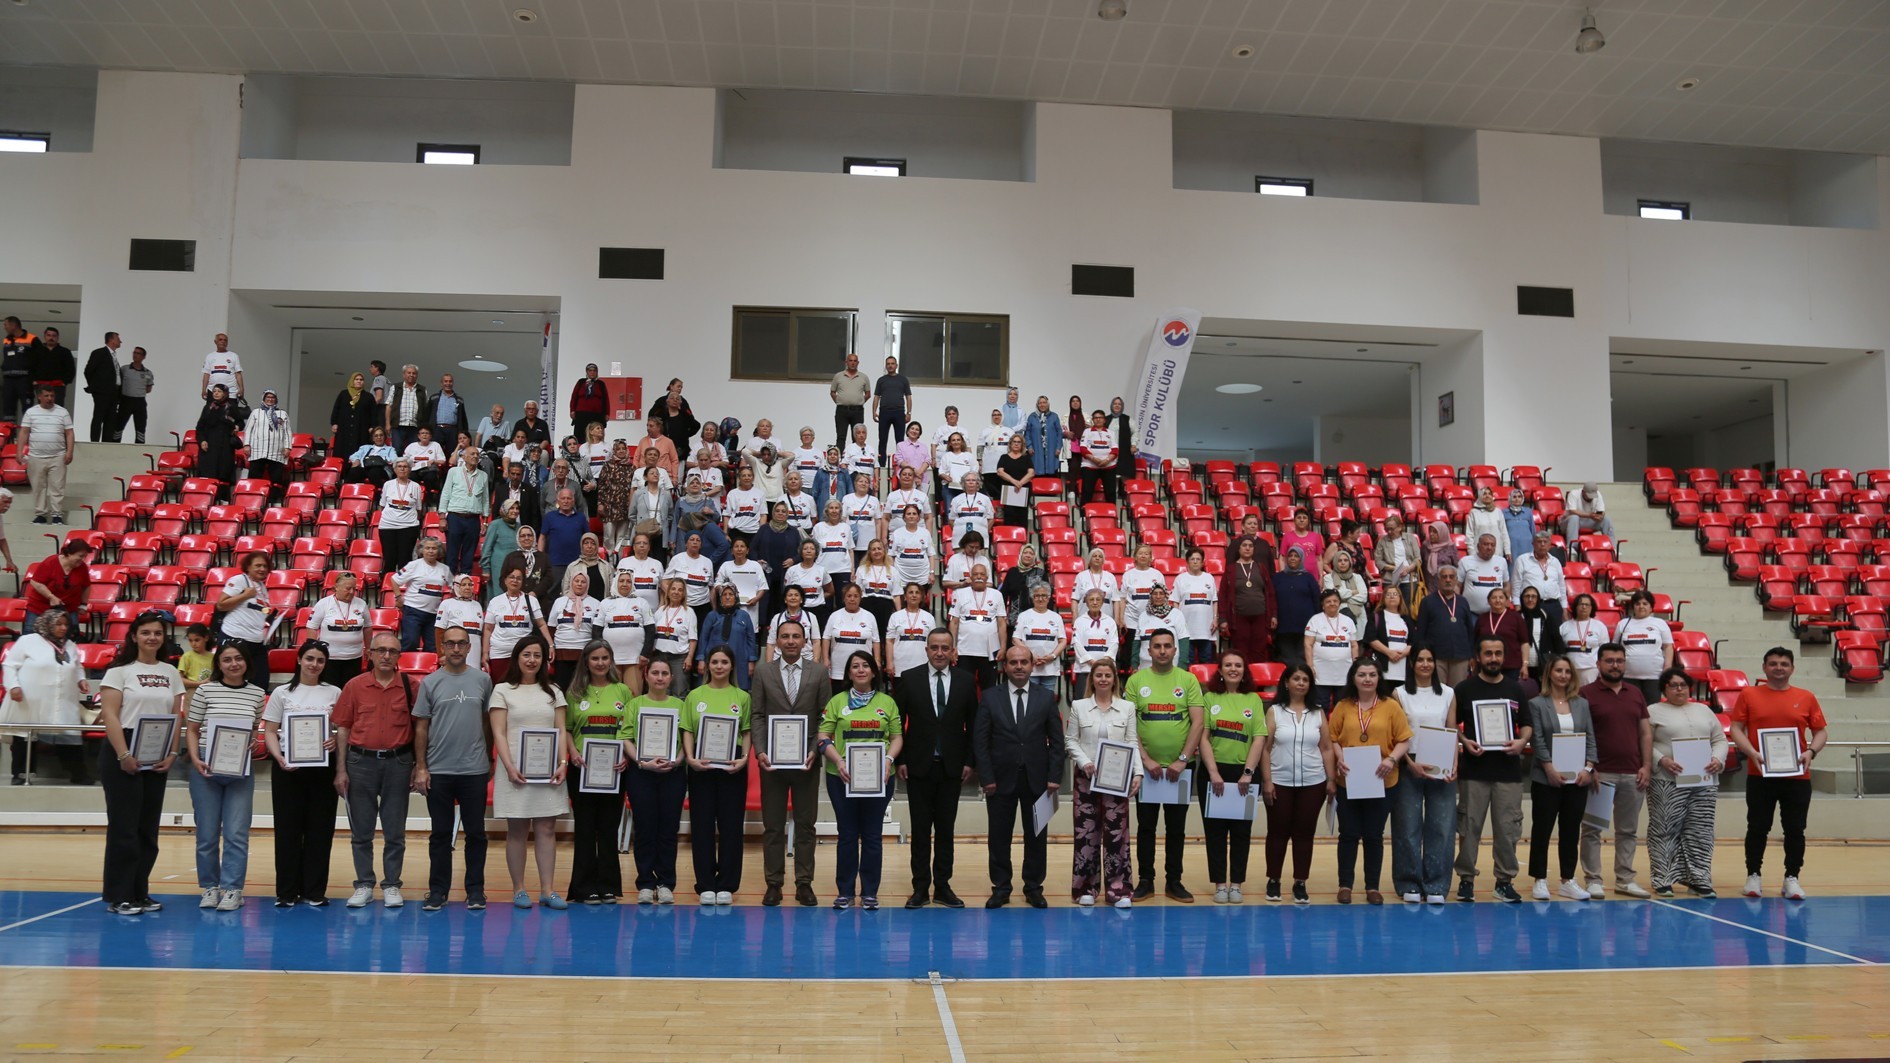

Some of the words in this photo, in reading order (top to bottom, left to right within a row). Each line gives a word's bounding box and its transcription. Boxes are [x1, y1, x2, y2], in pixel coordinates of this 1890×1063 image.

[1140, 363, 1158, 409] ÜNİVERSİTESİ
[1144, 413, 1161, 447] SPOR
[1153, 359, 1176, 411] KULÜBÜ
[1148, 702, 1176, 712] MERSİN
[851, 719, 880, 729] MERSİN
